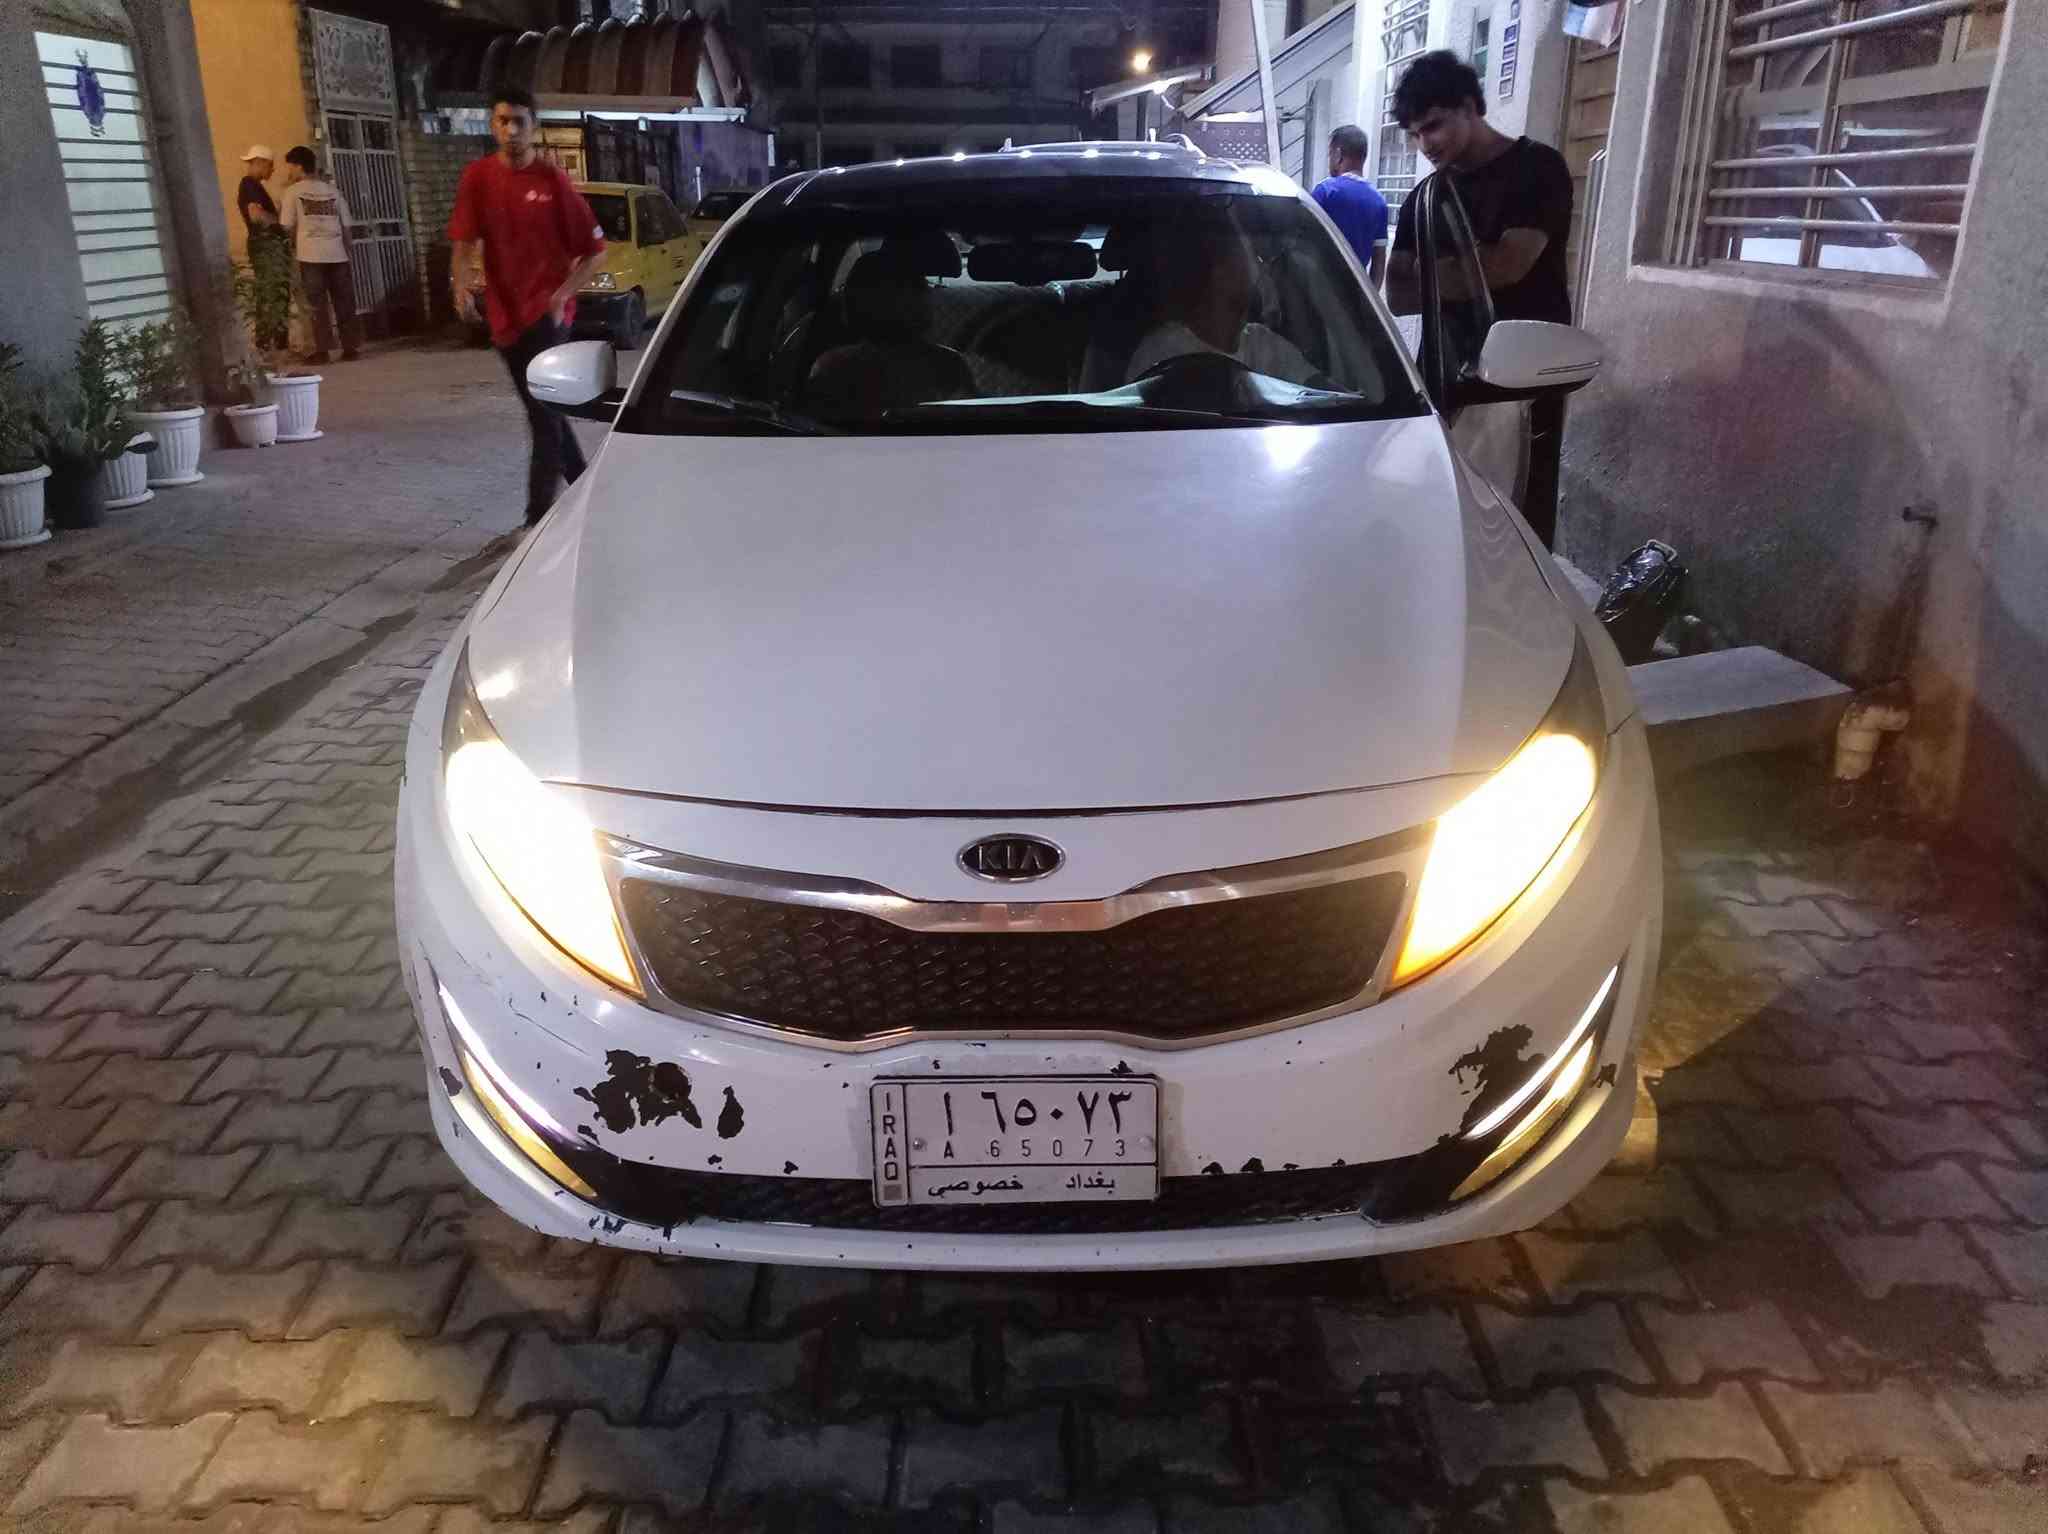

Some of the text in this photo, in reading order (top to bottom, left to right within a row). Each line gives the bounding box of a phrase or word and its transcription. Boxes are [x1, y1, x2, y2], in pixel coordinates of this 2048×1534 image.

[978, 843, 1044, 870] KIA
[882, 1092, 898, 1181] IRAQ
[943, 1142, 954, 1159] A
[1065, 1172, 1115, 1195] بغداد
